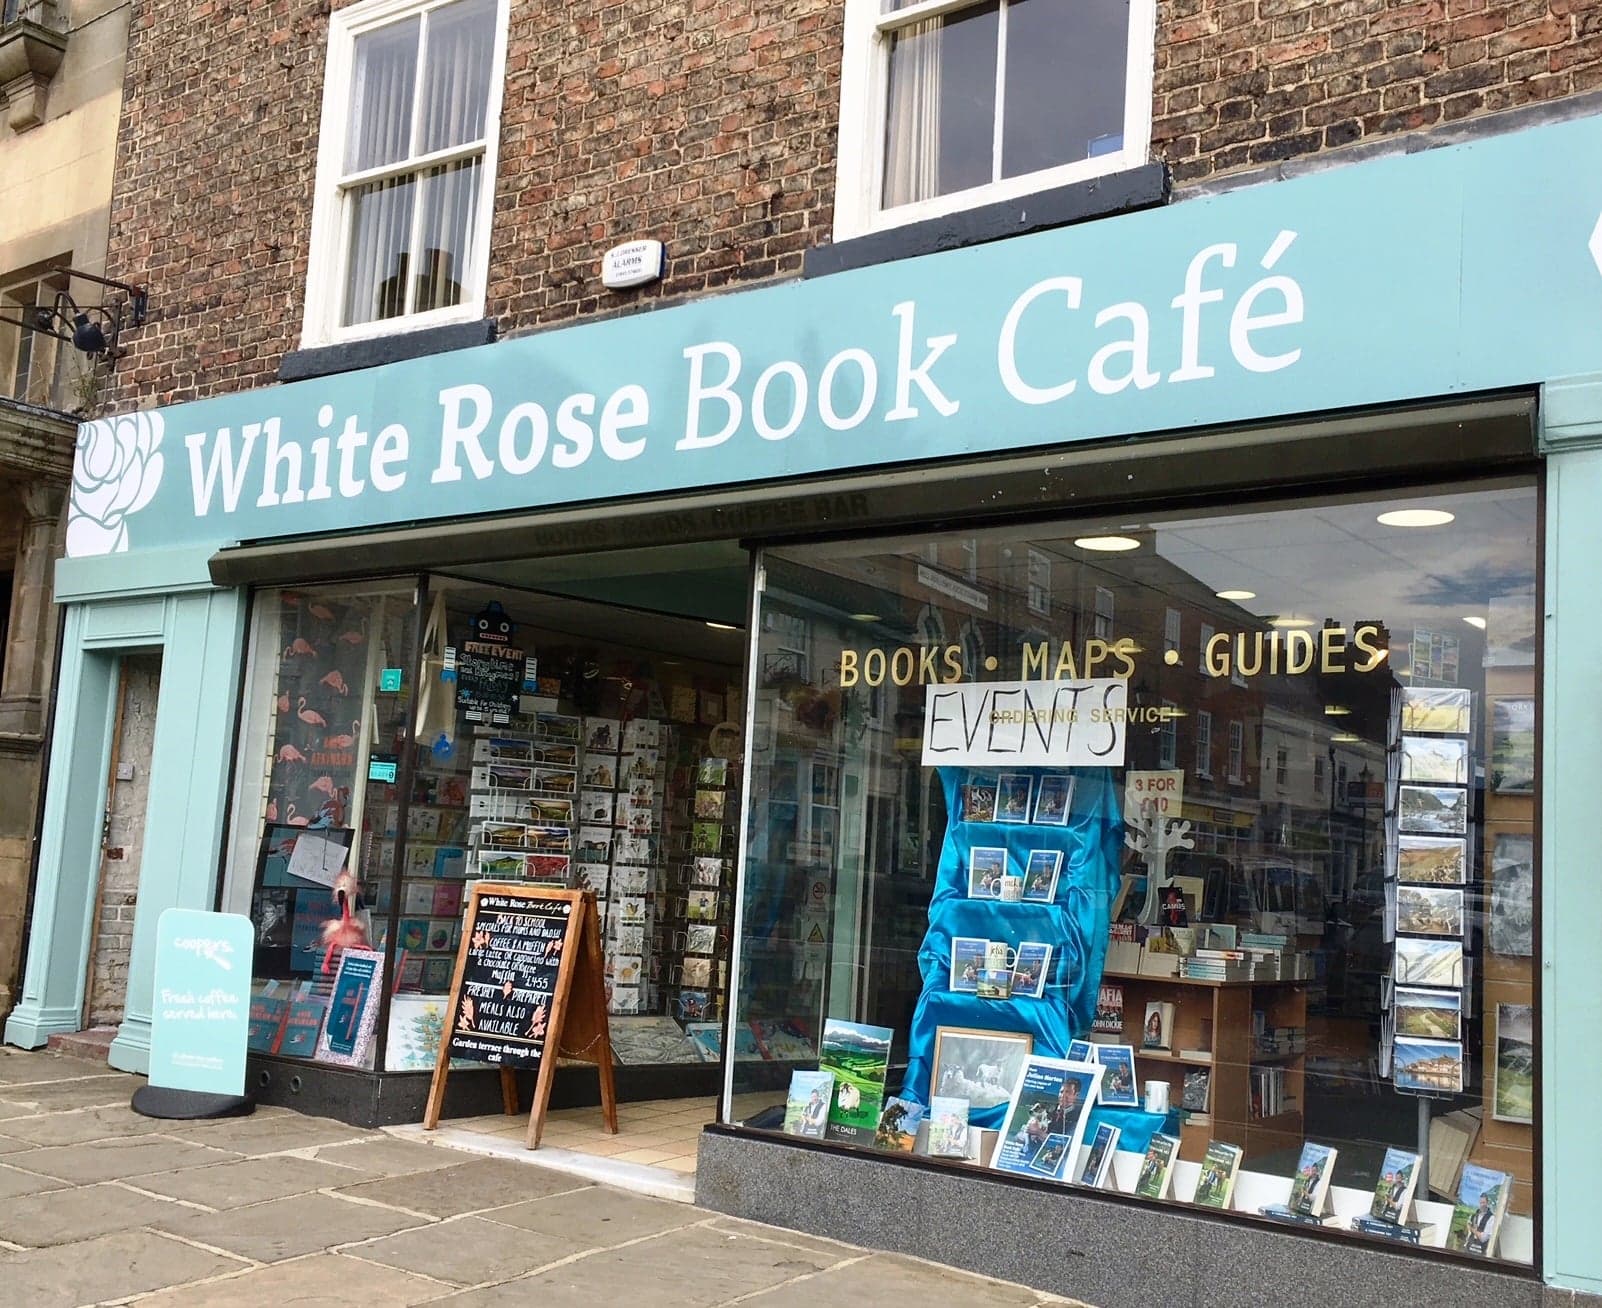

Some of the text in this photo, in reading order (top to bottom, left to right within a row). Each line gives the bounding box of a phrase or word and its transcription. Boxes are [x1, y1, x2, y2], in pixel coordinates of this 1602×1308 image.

[184, 230, 1306, 517] White Rose Book Café
[839, 625, 1388, 688] BOOKS MAPS GUIDES
[927, 684, 1124, 757] EVENTS
[988, 706, 1171, 725] ORDERING SERVICE
[1135, 777, 1176, 792] 3 FOR
[489, 897, 508, 907] White
[509, 898, 526, 909] Rose
[501, 923, 513, 934] FOR
[523, 917, 546, 929] SCHOOL
[489, 937, 511, 949] COFFEE
[511, 991, 547, 1006] PREPARED
[479, 1001, 526, 1020] MEALS ALSO
[478, 1019, 519, 1036] AVAILABLE
[452, 1037, 542, 1058] Garden terrace through the
[487, 1053, 502, 1062] cafe
